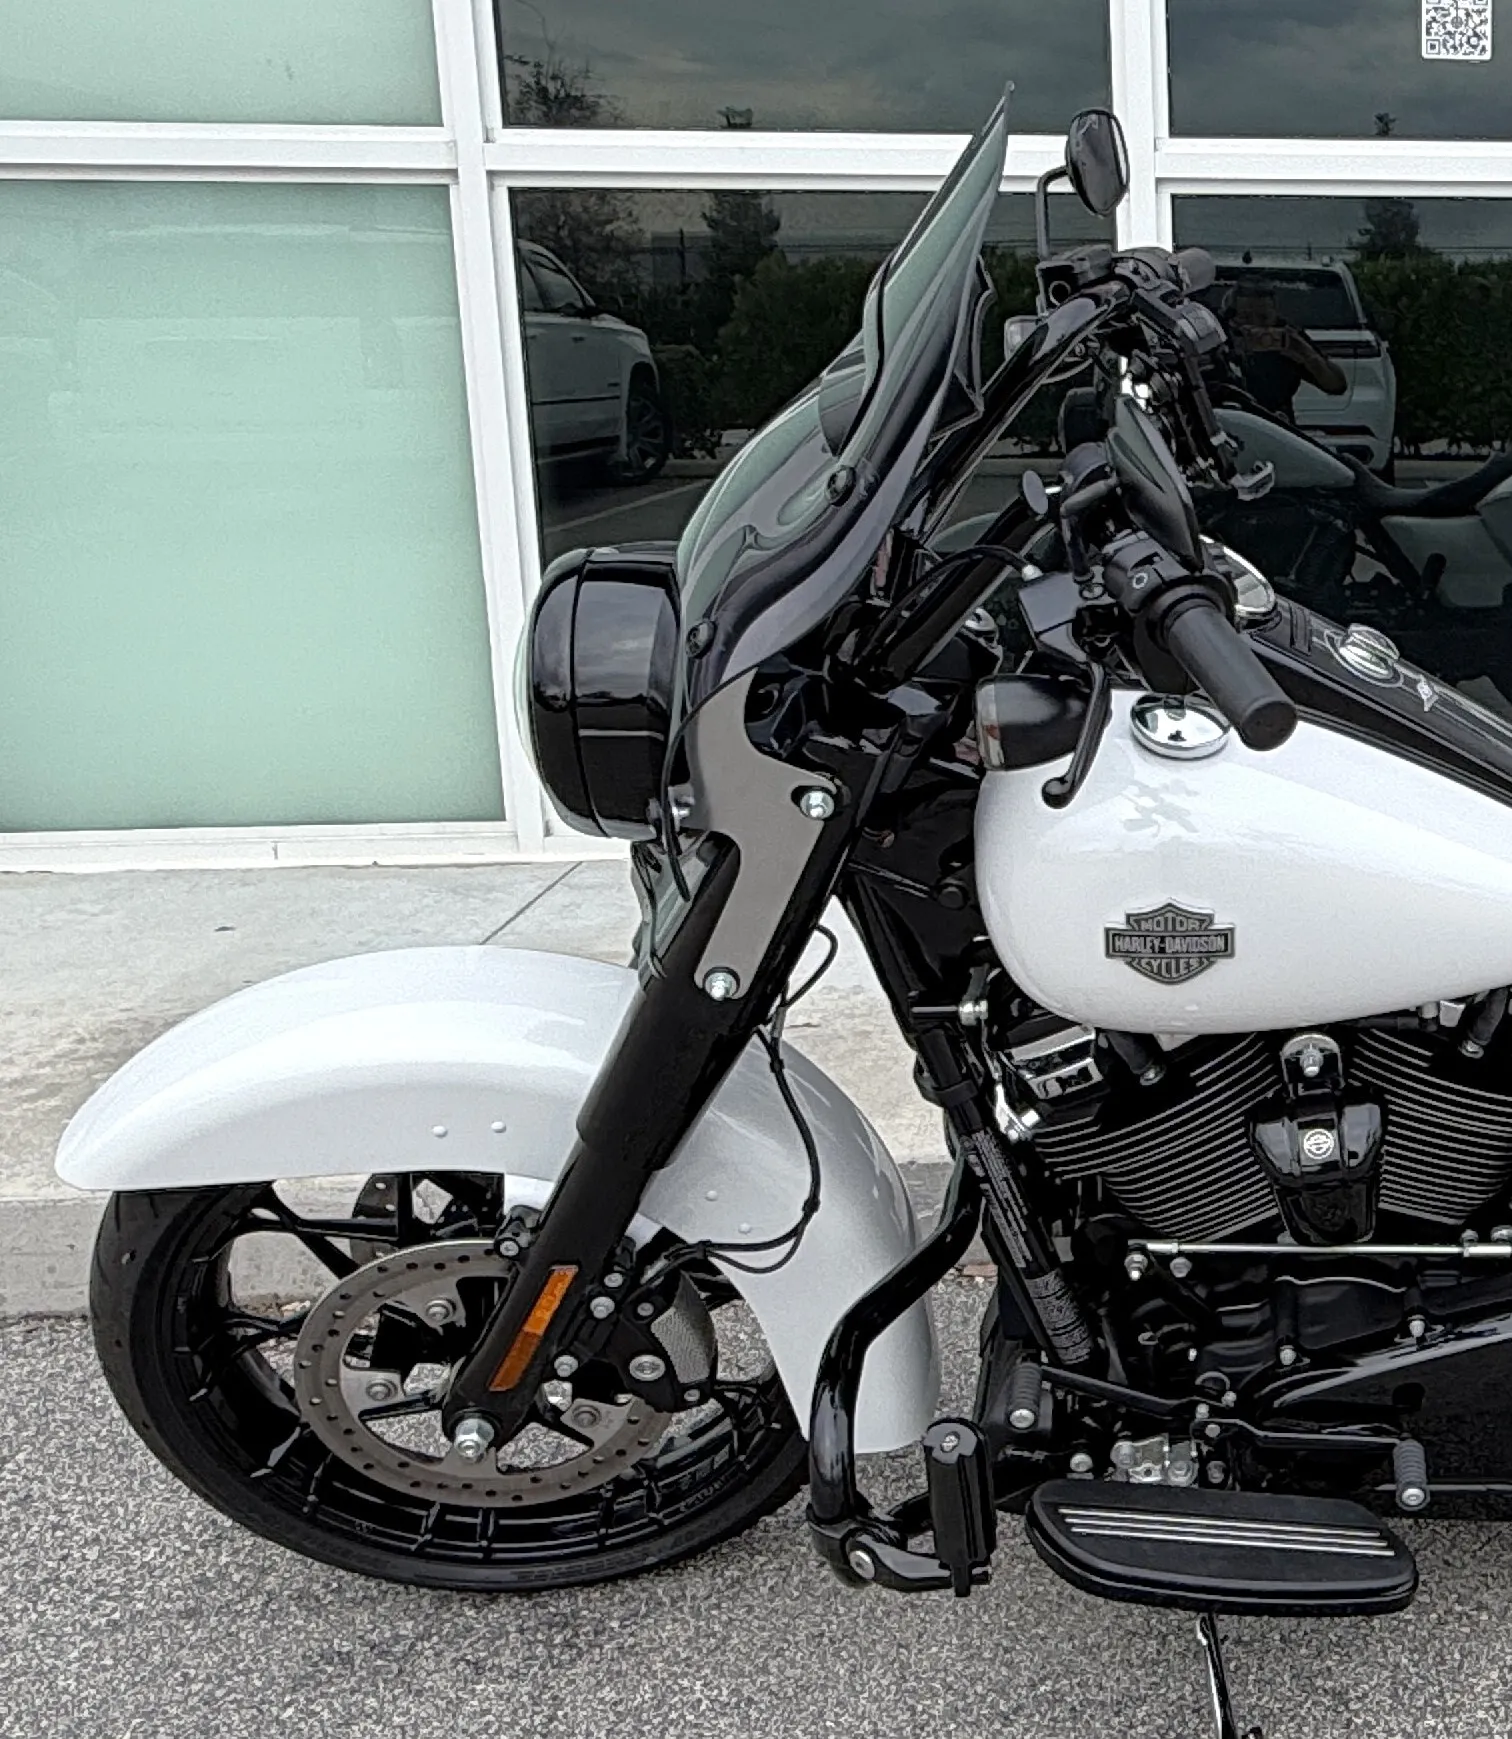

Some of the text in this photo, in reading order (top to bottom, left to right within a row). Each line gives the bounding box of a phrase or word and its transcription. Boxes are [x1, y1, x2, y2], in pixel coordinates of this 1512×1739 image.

[1140, 912, 1201, 932] MOTOR
[1114, 935, 1225, 953] HARLEY-DAVIDSON
[1139, 957, 1199, 978] CYCLES
